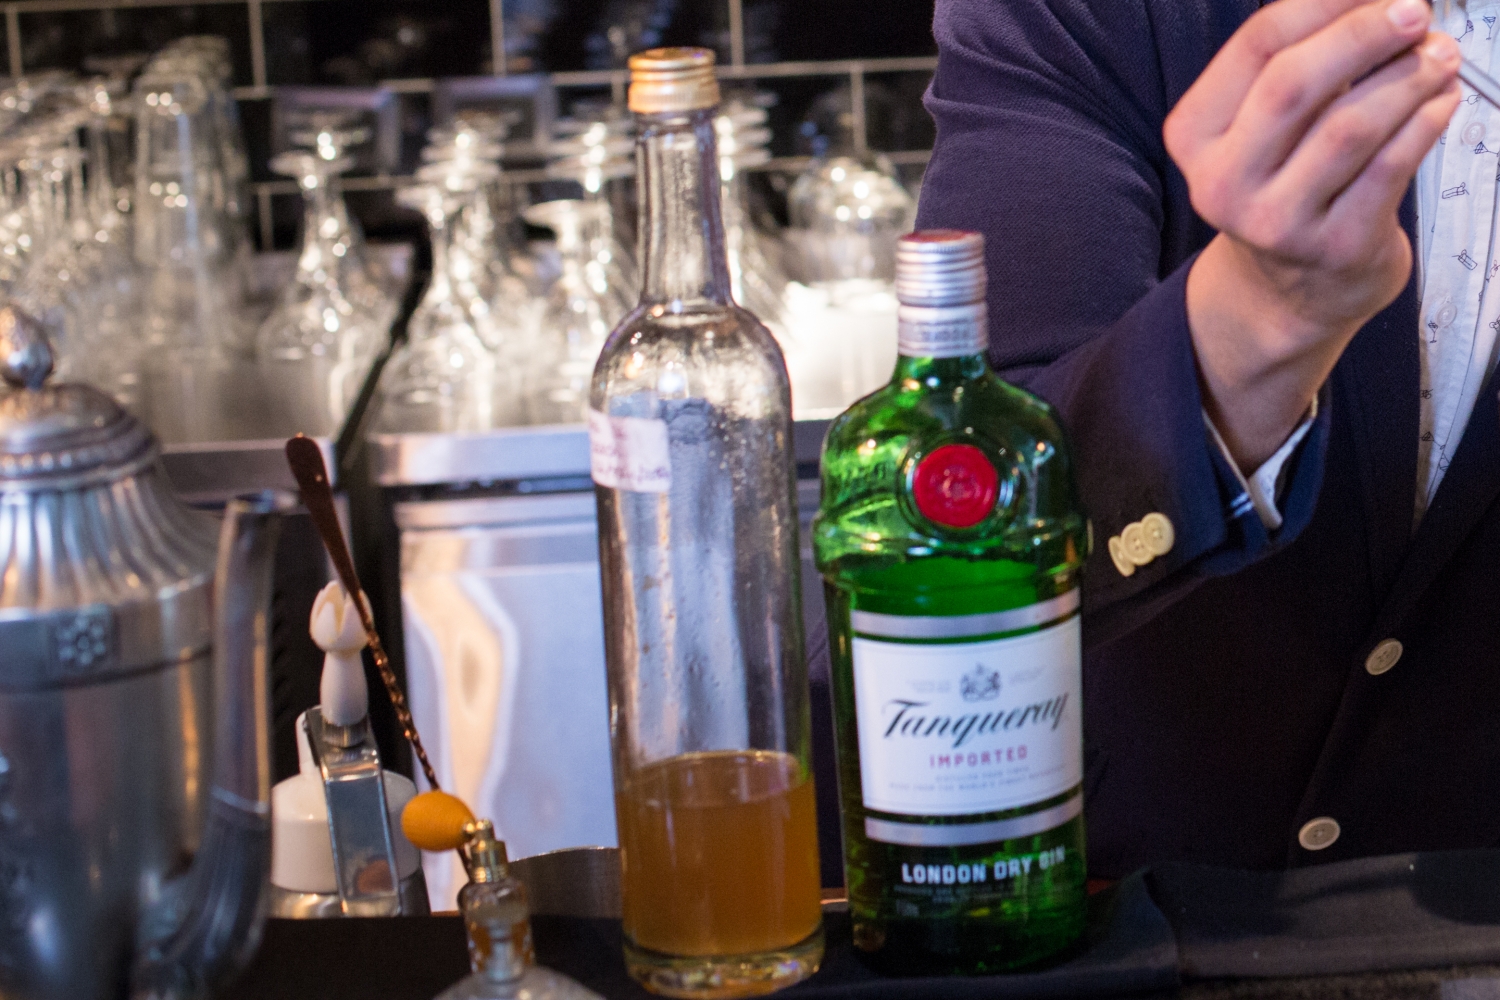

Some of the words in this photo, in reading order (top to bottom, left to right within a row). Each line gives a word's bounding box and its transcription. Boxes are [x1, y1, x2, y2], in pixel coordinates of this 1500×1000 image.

[880, 692, 1070, 748] Tanqueray
[929, 745, 1028, 768] IMPORTED
[901, 863, 988, 885] LONDON
[993, 856, 1033, 881] DRY
[1039, 845, 1066, 870] GIN
